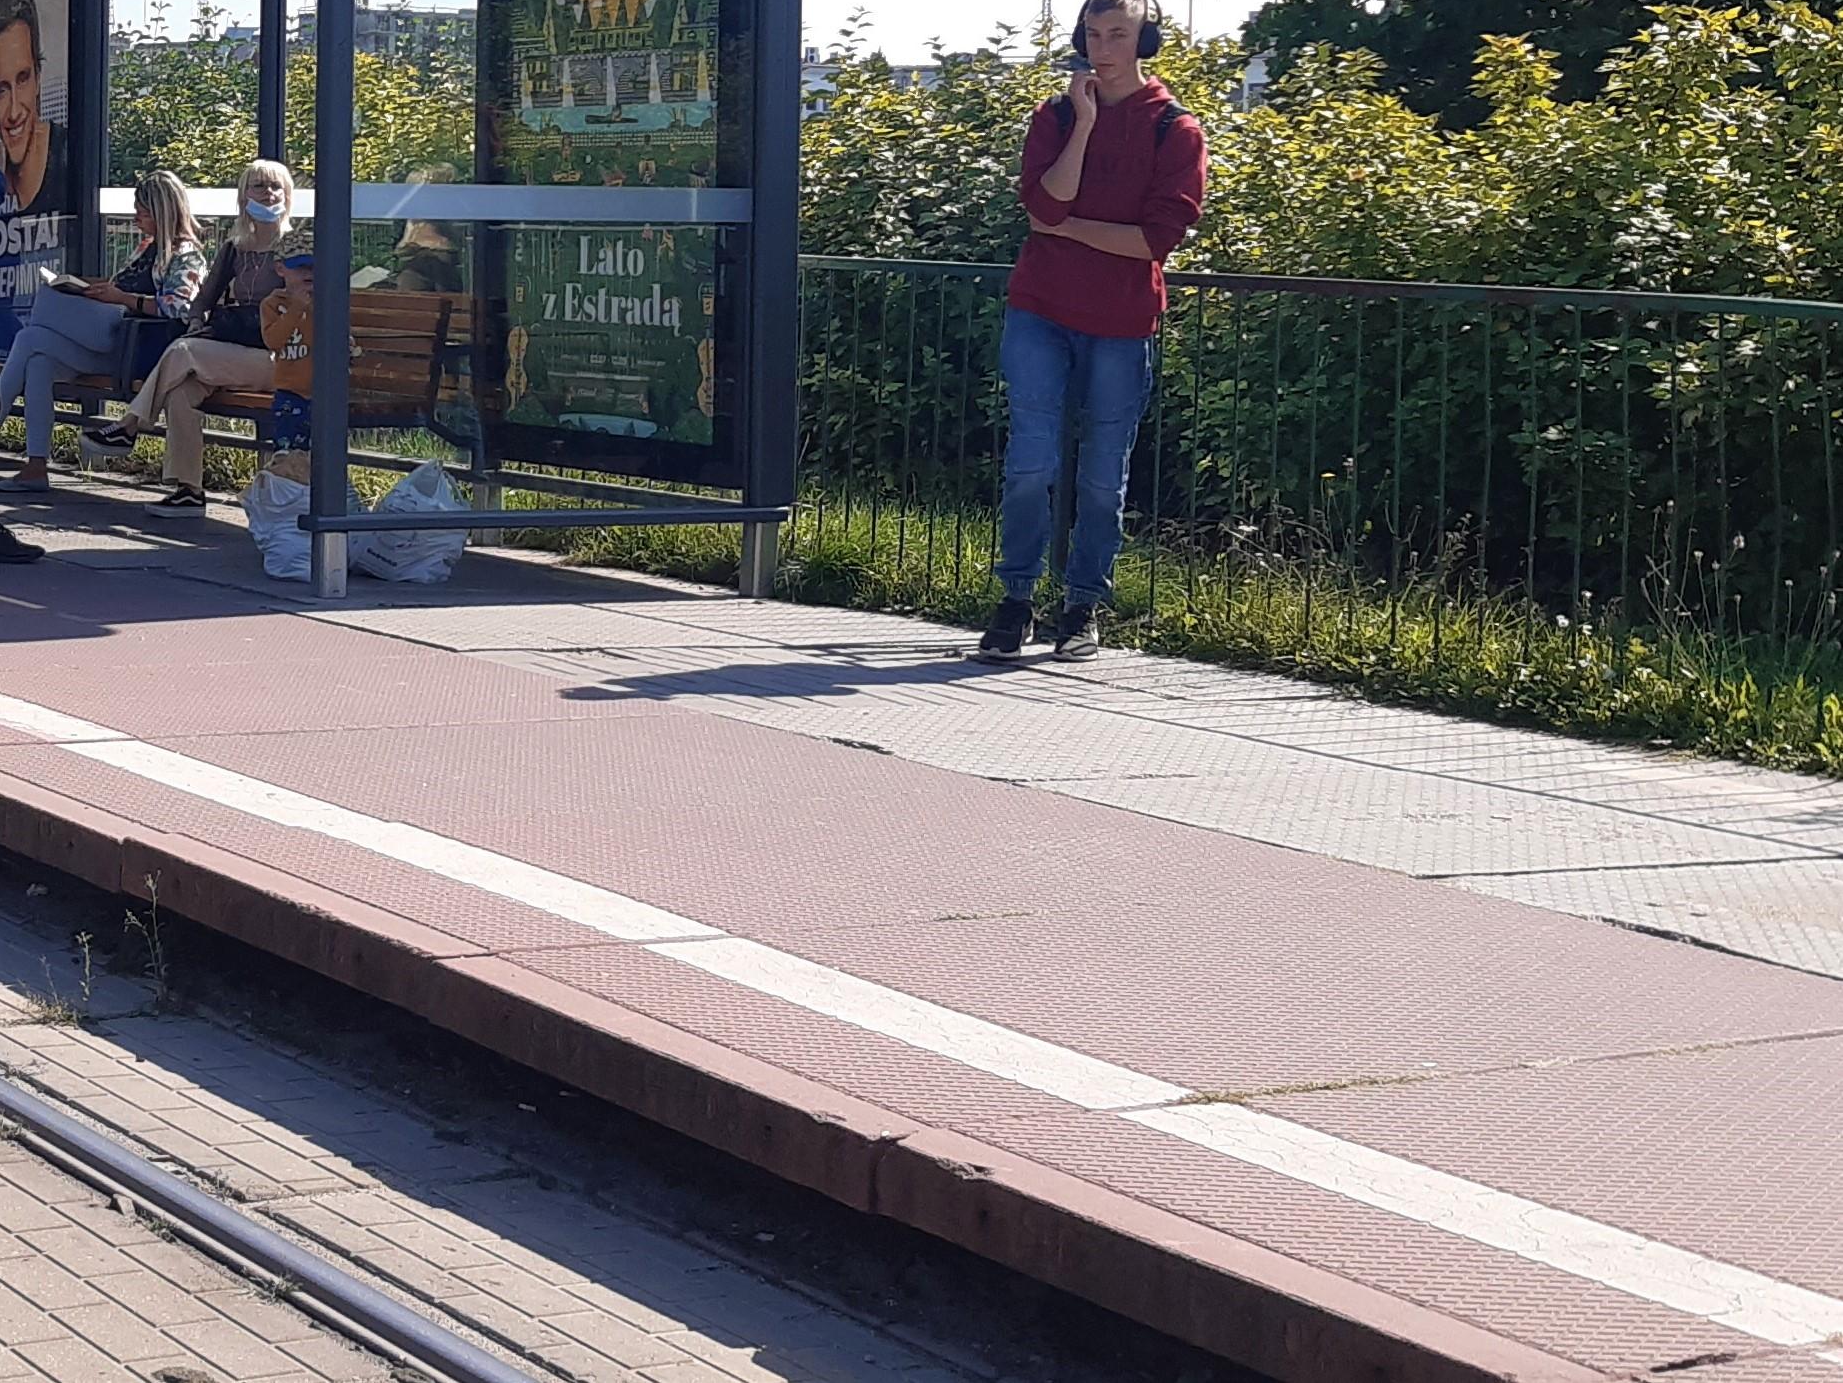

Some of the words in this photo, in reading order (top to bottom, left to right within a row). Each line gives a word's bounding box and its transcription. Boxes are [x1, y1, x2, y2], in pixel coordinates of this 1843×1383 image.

[577, 235, 645, 277] Lato
[542, 293, 557, 320] z
[564, 282, 682, 337] Estradą
